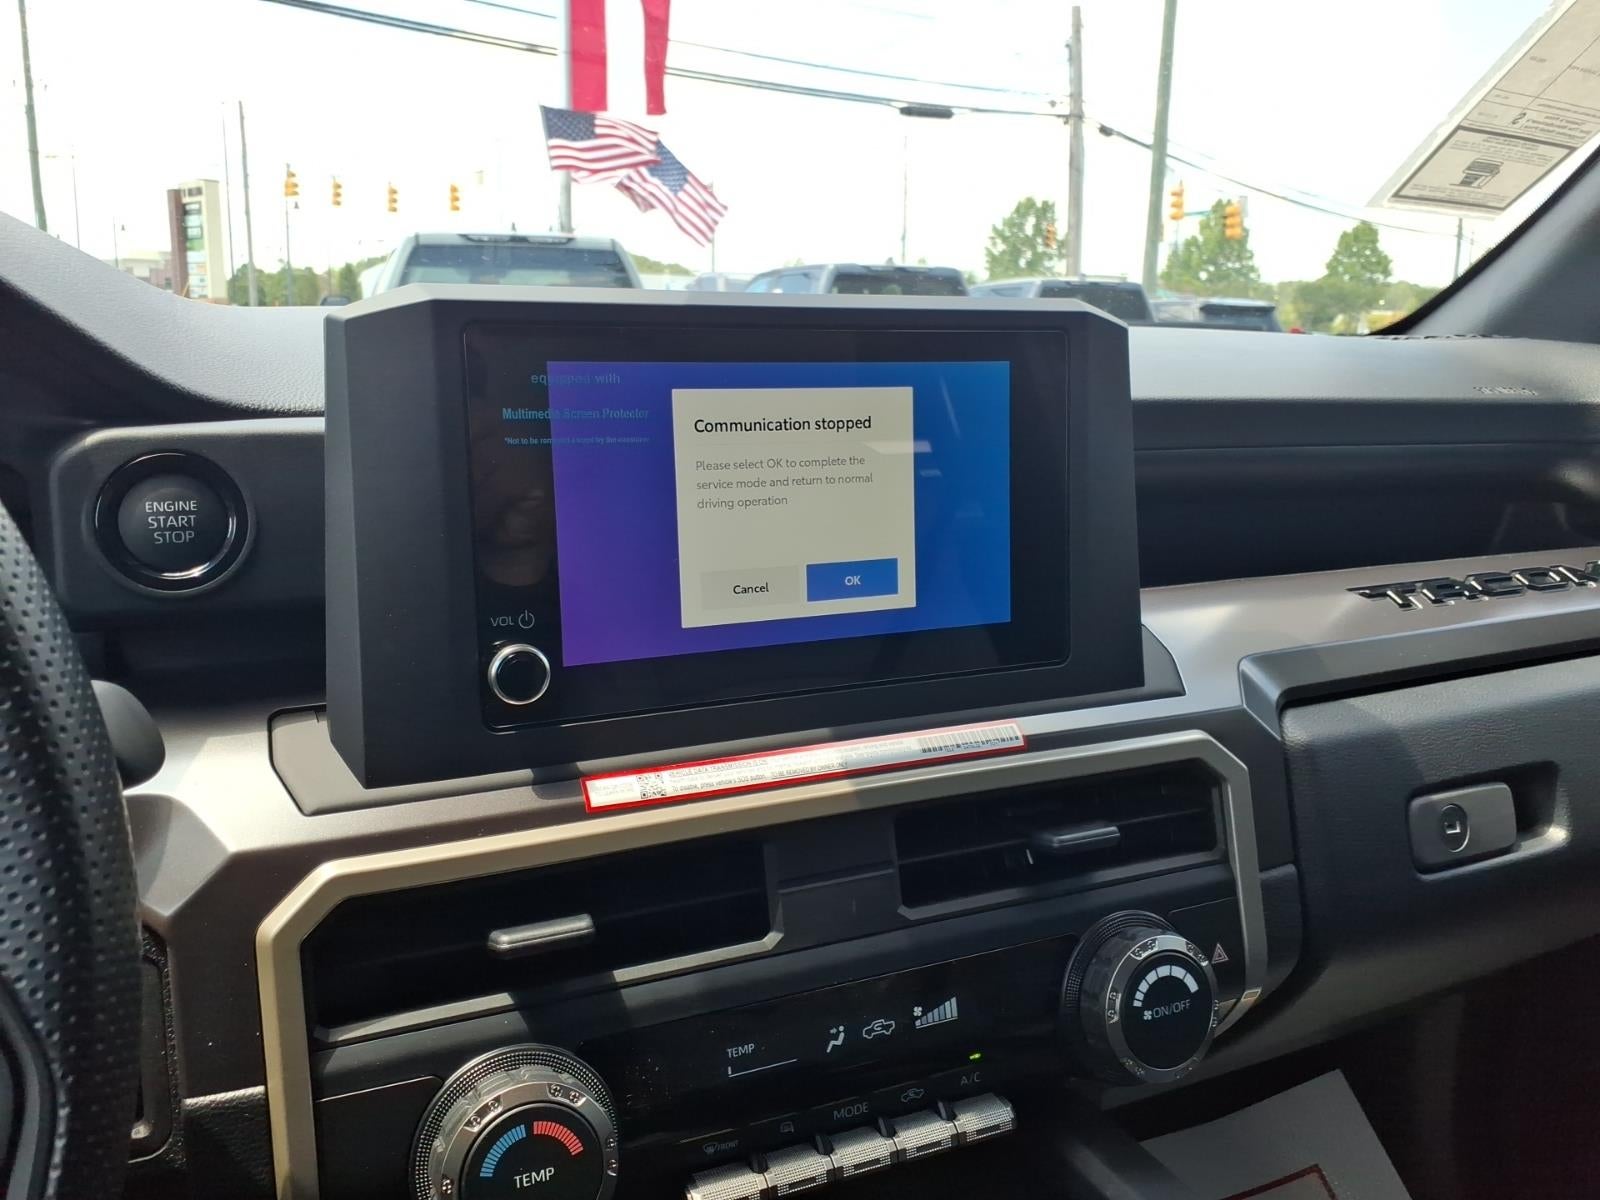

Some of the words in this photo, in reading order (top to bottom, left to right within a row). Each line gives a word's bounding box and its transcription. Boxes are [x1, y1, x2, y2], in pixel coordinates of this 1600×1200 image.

[594, 372, 621, 385] with
[602, 408, 648, 419] Protector
[694, 417, 811, 433] Communication
[815, 415, 872, 432] stopped
[695, 460, 731, 471] Please
[733, 458, 764, 470] select
[766, 458, 783, 469] OK
[785, 458, 797, 468] to
[798, 456, 847, 470] complete
[849, 456, 866, 466] the
[696, 479, 734, 490] service
[736, 477, 767, 488] mode
[769, 476, 790, 487] and
[792, 476, 823, 487] return
[825, 474, 836, 485] to
[838, 473, 873, 484] normal
[145, 500, 198, 513] ENGINE
[697, 497, 735, 510] driving
[737, 495, 788, 509] operation
[148, 514, 196, 529] START
[153, 530, 195, 544] STOP
[844, 575, 861, 586] OK
[732, 582, 769, 595] Cancel
[490, 615, 515, 627] VOL
[1153, 999, 1191, 1018] ON/OFF
[727, 1043, 755, 1059] TEMP
[960, 1071, 982, 1087] A/C
[833, 1101, 869, 1120] MODE
[514, 1167, 555, 1189] TEMP
